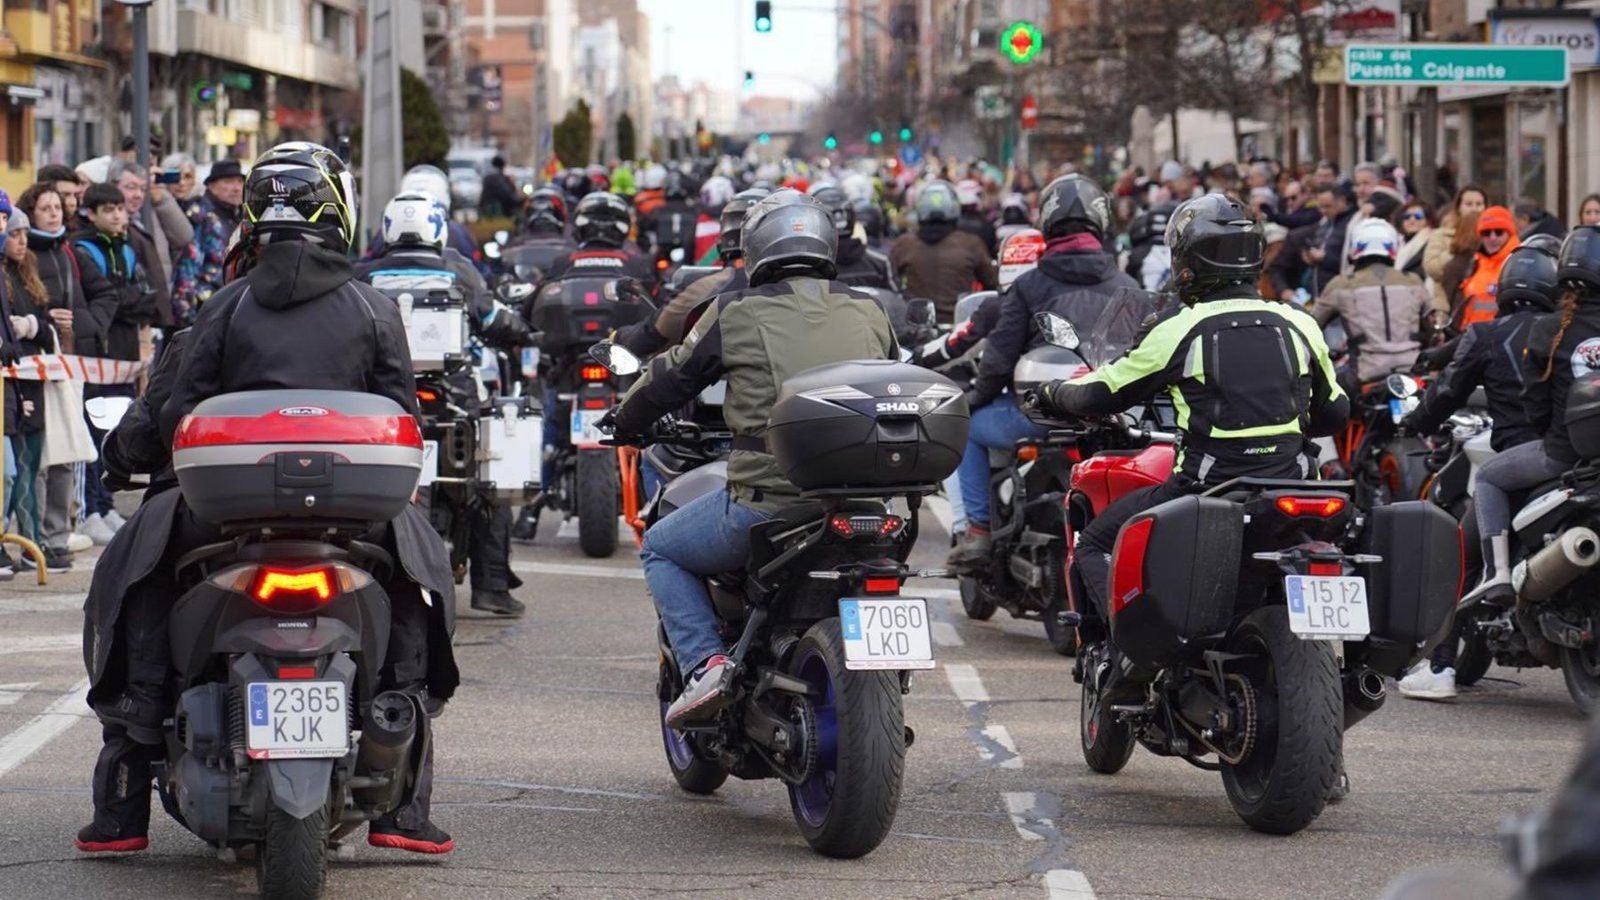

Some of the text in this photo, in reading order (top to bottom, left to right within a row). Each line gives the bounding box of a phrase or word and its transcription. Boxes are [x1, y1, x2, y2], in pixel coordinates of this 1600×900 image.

[1350, 48, 1412, 60] calle del
[1350, 62, 1506, 80] Puente Colgante
[573, 257, 623, 268] HONDA
[876, 402, 919, 412] SHAD
[1243, 445, 1278, 455] AIRFLOW
[1310, 580, 1362, 604] 1512
[864, 605, 922, 630] 7060
[1307, 605, 1350, 628] LRC
[865, 632, 910, 656] LKD
[273, 687, 340, 713] 2365
[273, 715, 323, 743] KJK
